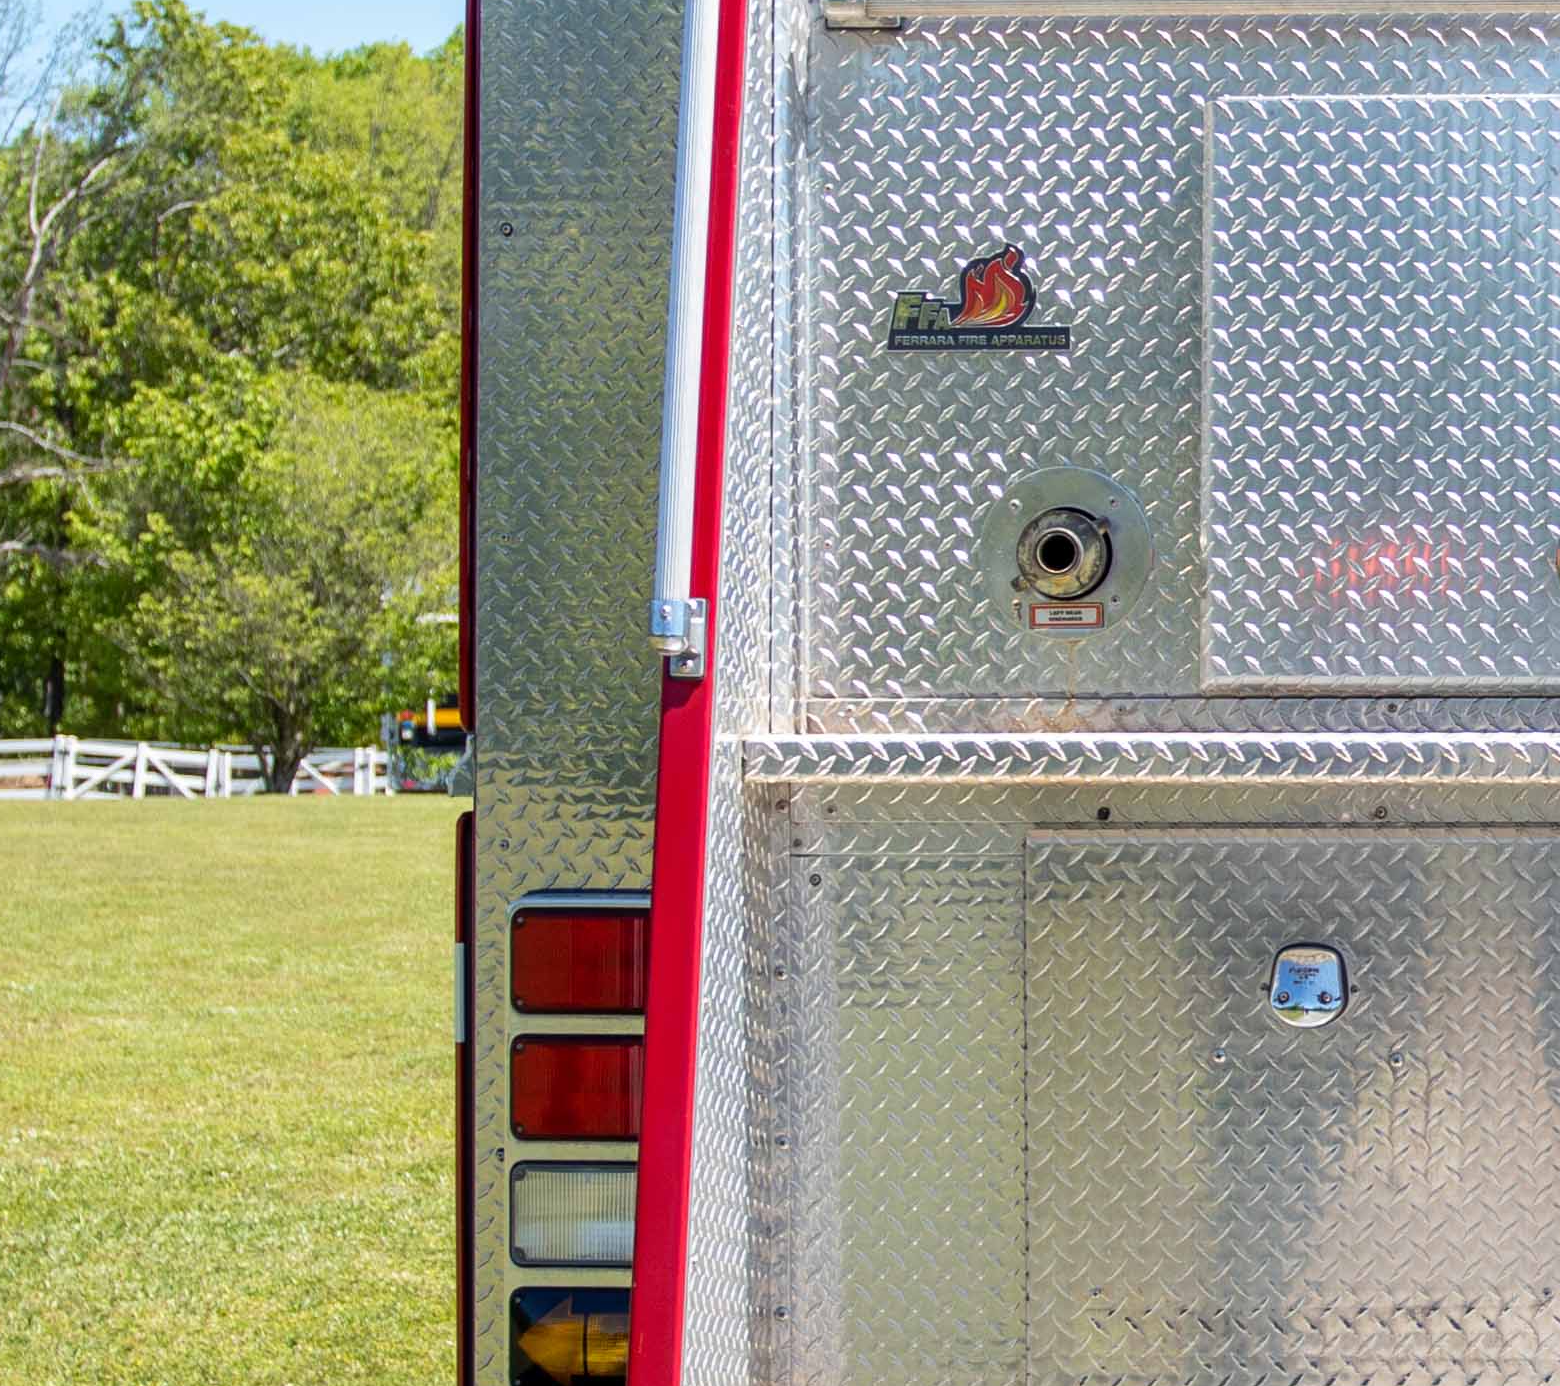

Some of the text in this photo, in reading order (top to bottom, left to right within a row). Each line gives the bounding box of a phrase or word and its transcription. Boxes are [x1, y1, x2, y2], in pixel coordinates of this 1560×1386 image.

[893, 294, 951, 330] FFA
[894, 335, 1066, 346] FERRARA FIRE APPARATUS
